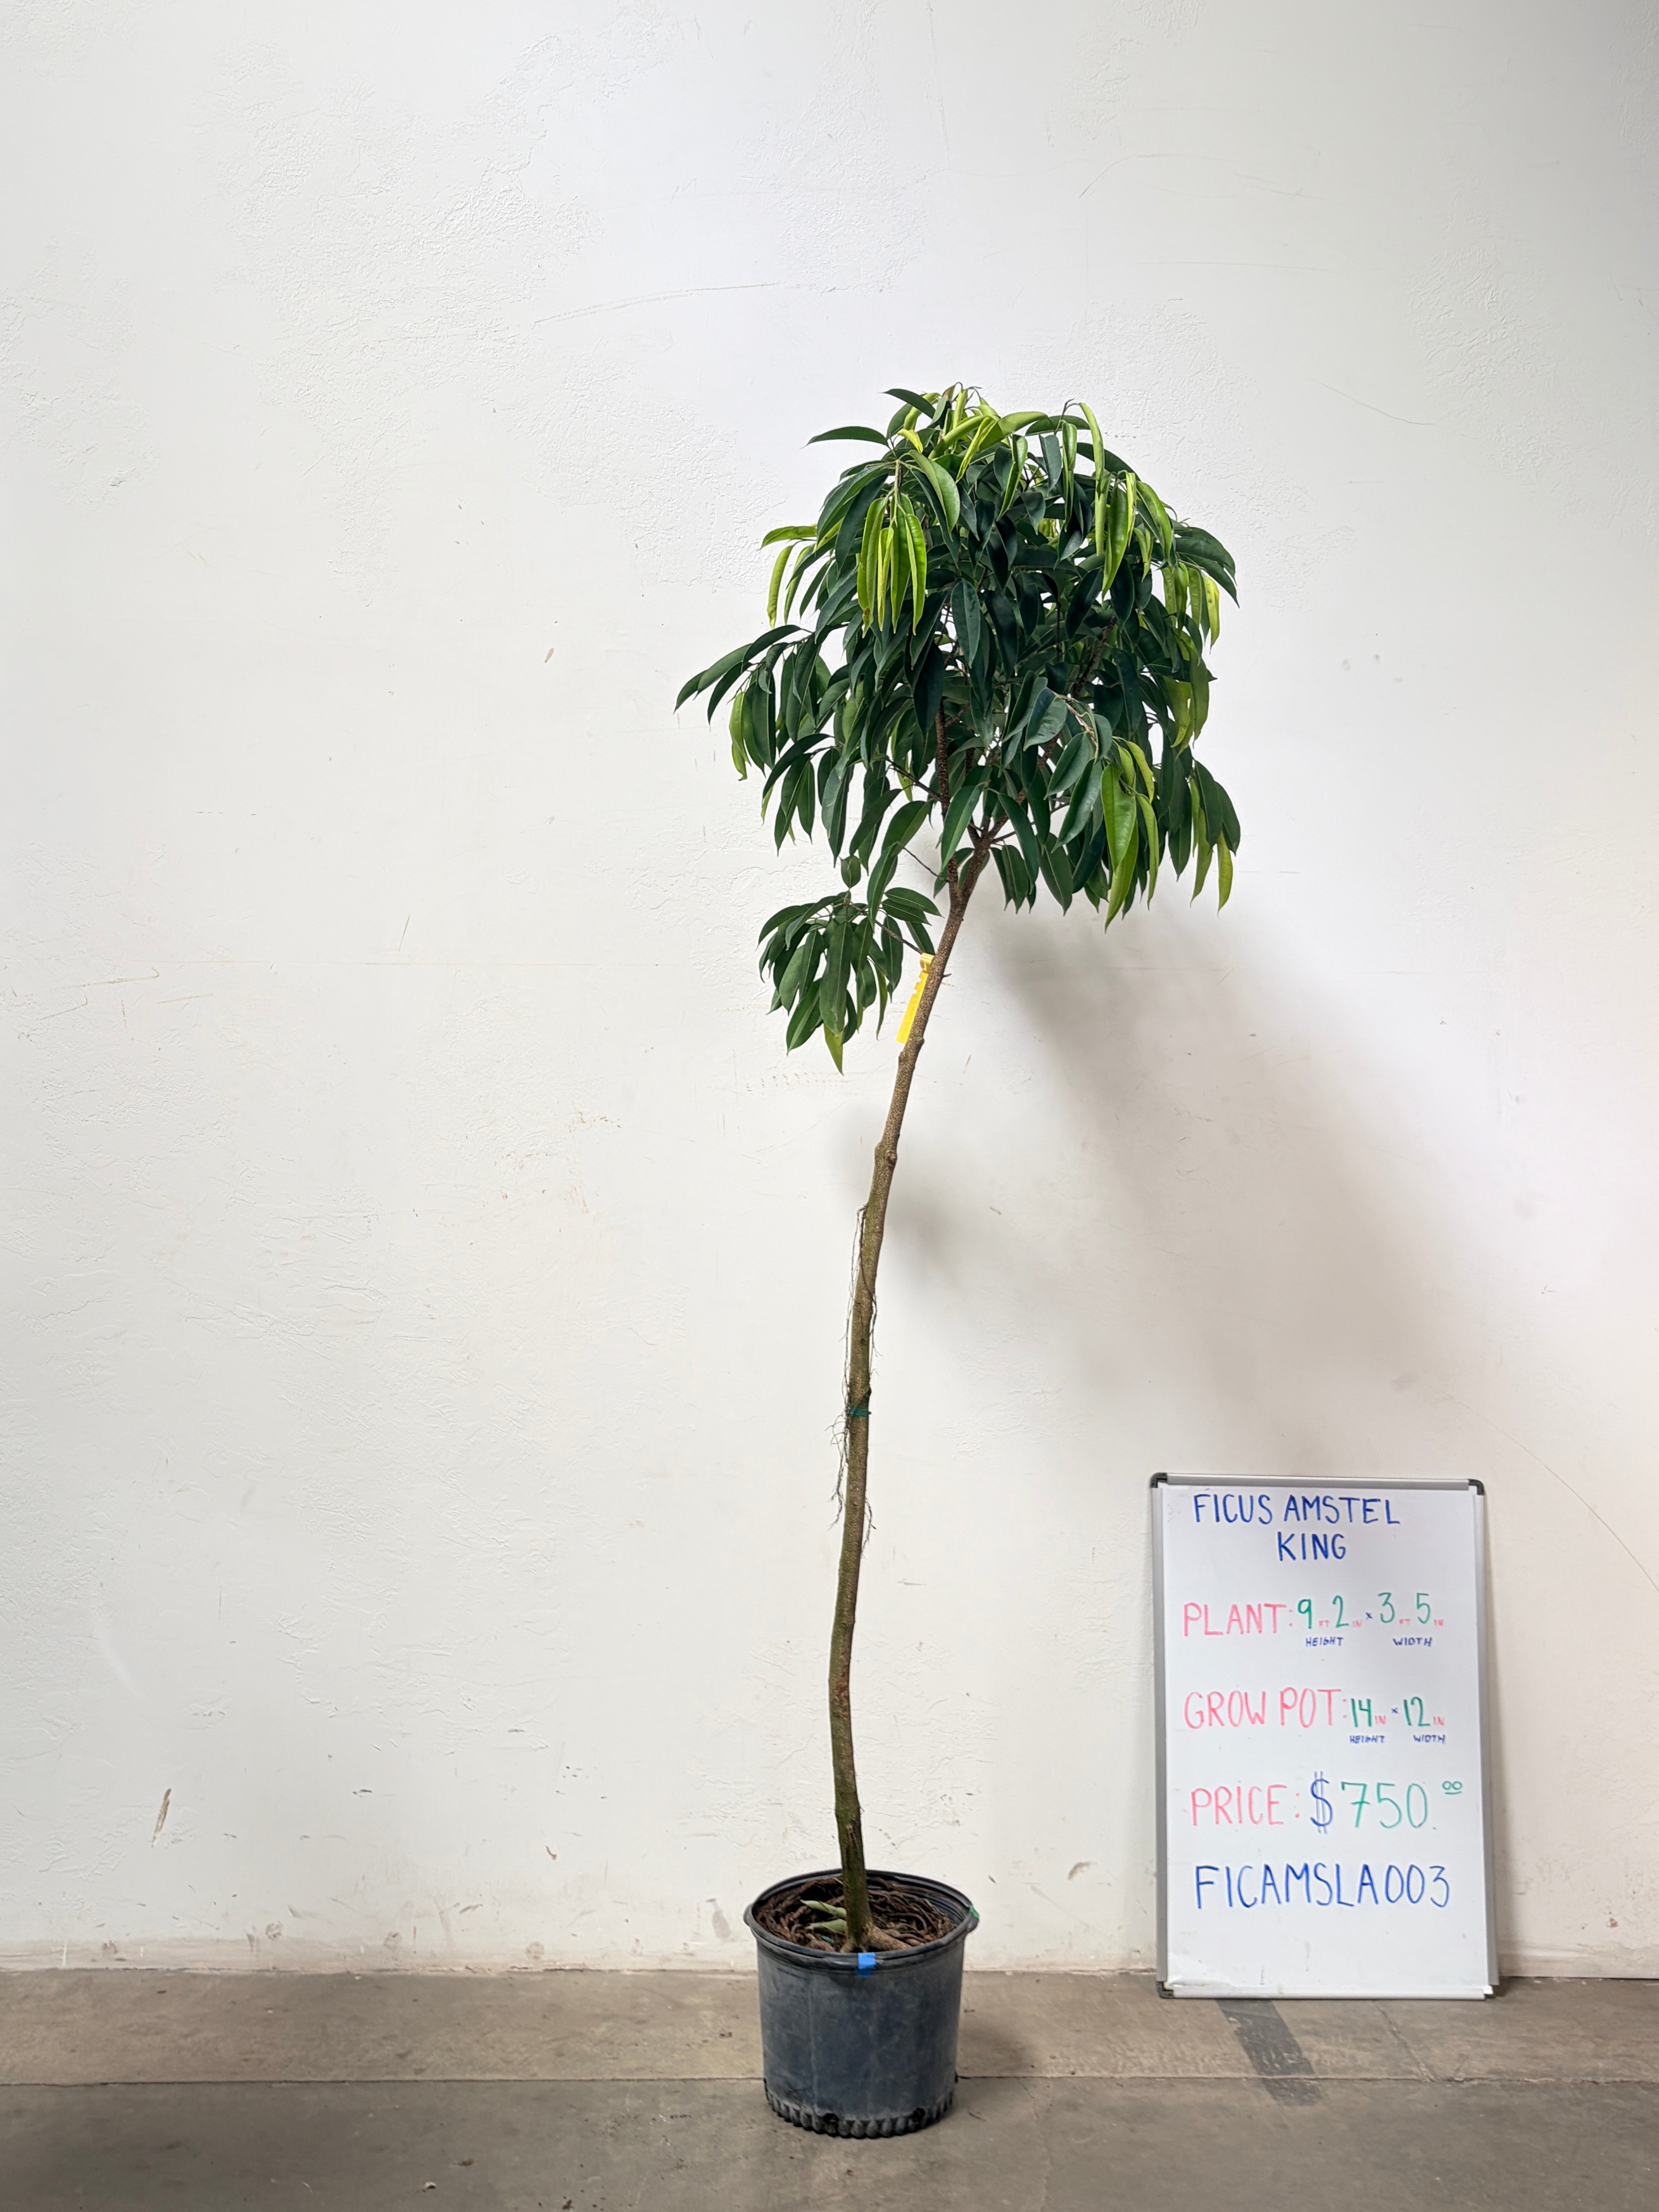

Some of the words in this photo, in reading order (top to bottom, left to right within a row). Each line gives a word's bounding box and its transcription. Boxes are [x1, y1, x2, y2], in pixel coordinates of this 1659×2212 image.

[1193, 1494, 1273, 1525] FICUS
[1283, 1494, 1400, 1525] AMSTEL
[1277, 1531, 1346, 1562] KING
[1305, 1637, 1343, 1647] HEIGHT
[1393, 1637, 1432, 1647] WIDTH
[1184, 1691, 1266, 1729] GROW
[1349, 1735, 1385, 1745] HEIGHT
[1413, 1735, 1446, 1744] WIDTH
[1190, 1784, 1300, 1827] PRICE:
[1195, 1862, 1450, 1910] FICAMSLA003
